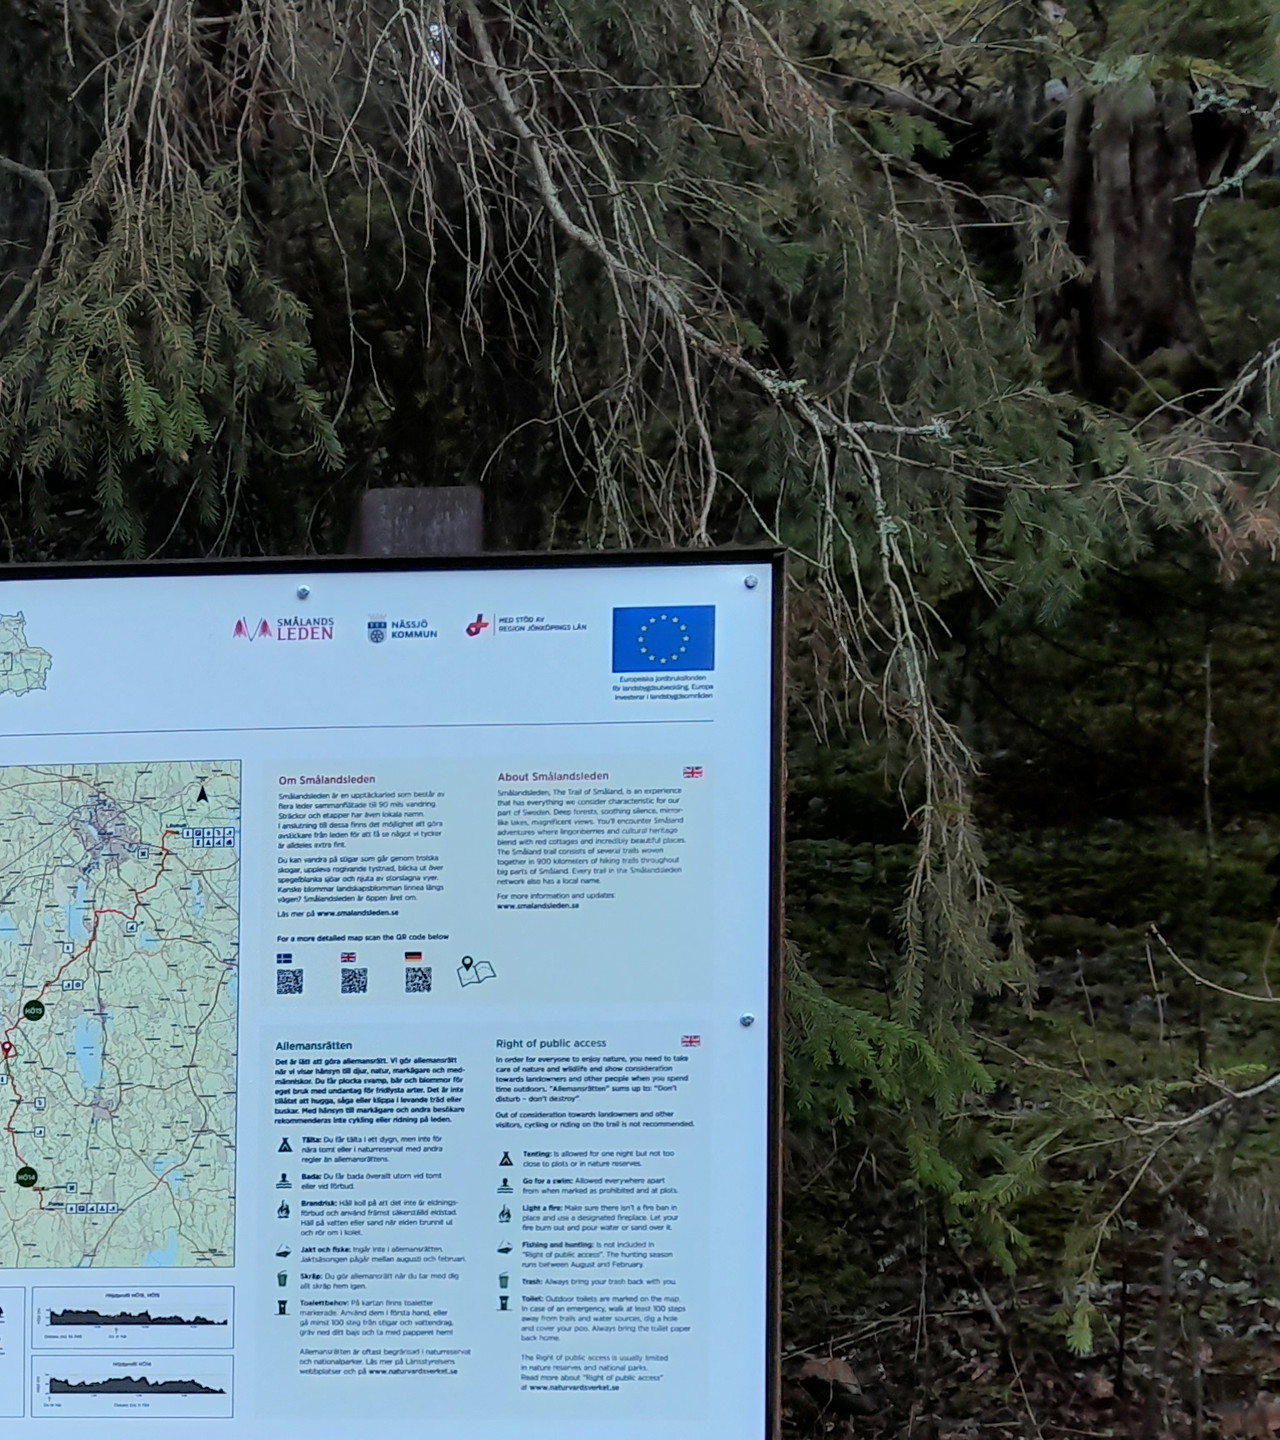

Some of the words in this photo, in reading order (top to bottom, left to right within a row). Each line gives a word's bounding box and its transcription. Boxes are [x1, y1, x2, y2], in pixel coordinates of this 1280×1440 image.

[277, 616, 334, 628] SMÅLANDS
[391, 619, 428, 629] NÄSSJÖ
[277, 626, 333, 641] LEDEN
[391, 630, 437, 638] KOMMUN
[279, 776, 296, 785] Om
[299, 774, 375, 785] Smålandsleden
[498, 773, 529, 781] About
[532, 771, 609, 781] Smålandsleden
[317, 934, 346, 942] detailed
[275, 1041, 352, 1050] Allemansrätten
[496, 1039, 523, 1050] Right
[526, 1039, 537, 1048] of
[540, 1039, 570, 1049] public
